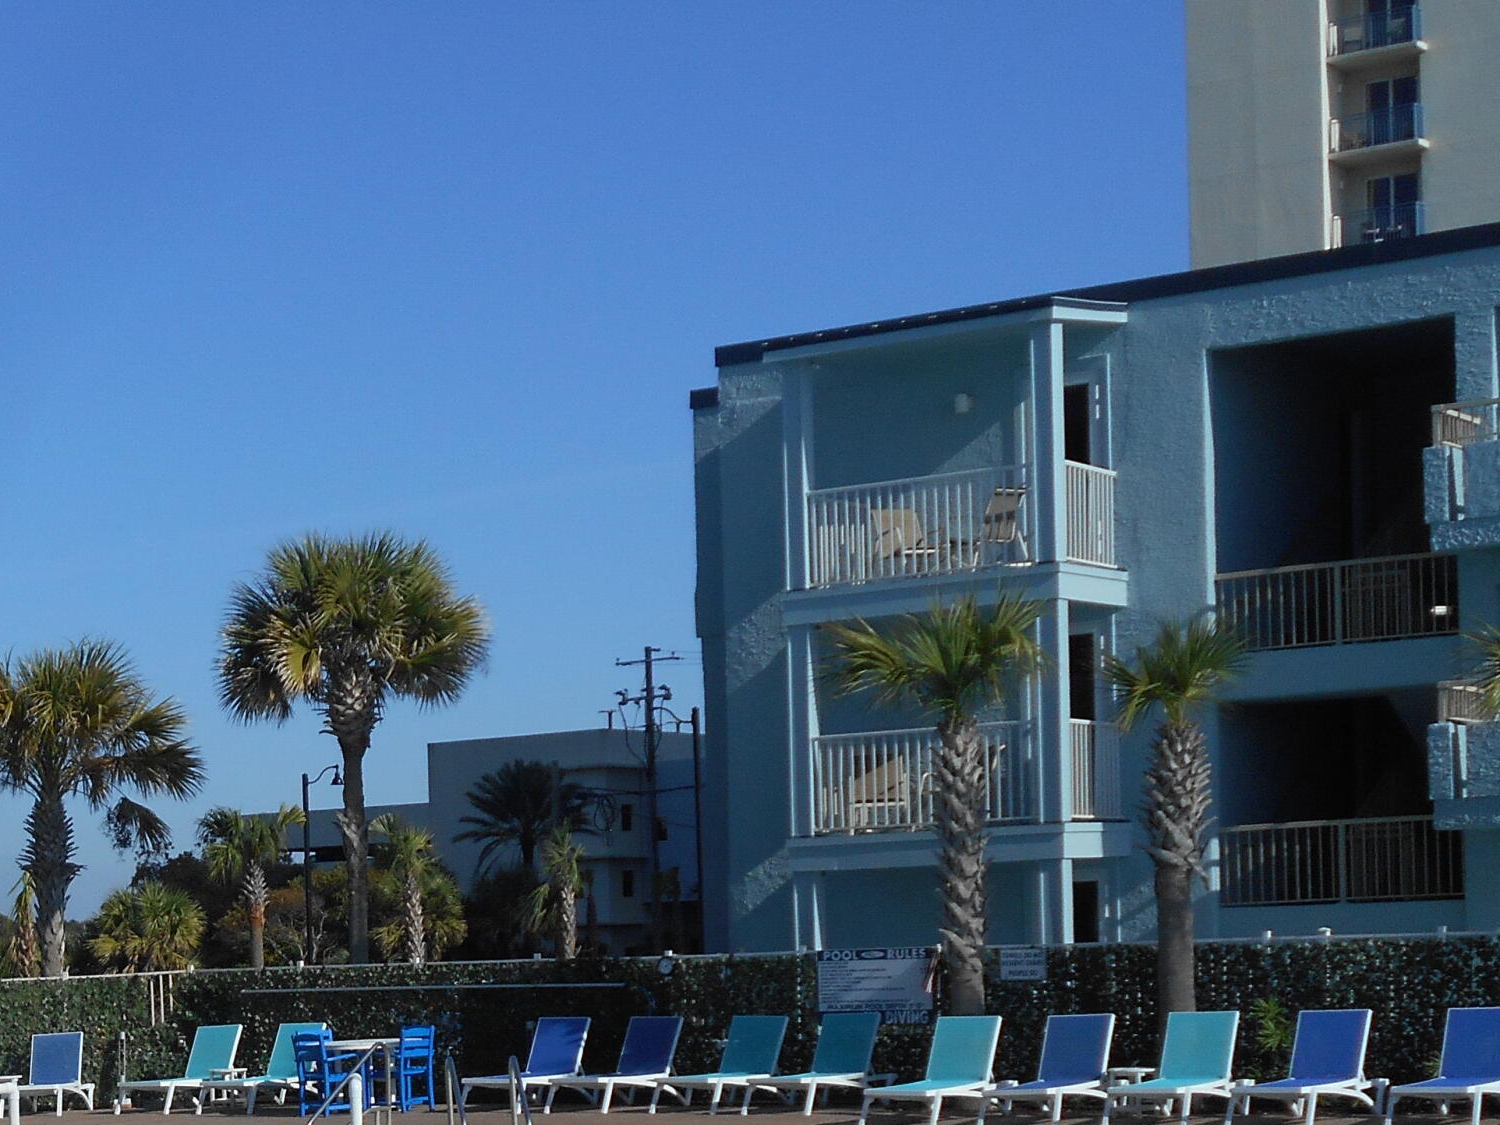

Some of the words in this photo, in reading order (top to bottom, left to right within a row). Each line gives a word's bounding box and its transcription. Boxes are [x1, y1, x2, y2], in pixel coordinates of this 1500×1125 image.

[823, 950, 859, 960] POOL
[887, 948, 927, 959] RULES
[885, 1010, 929, 1024] DIVING
